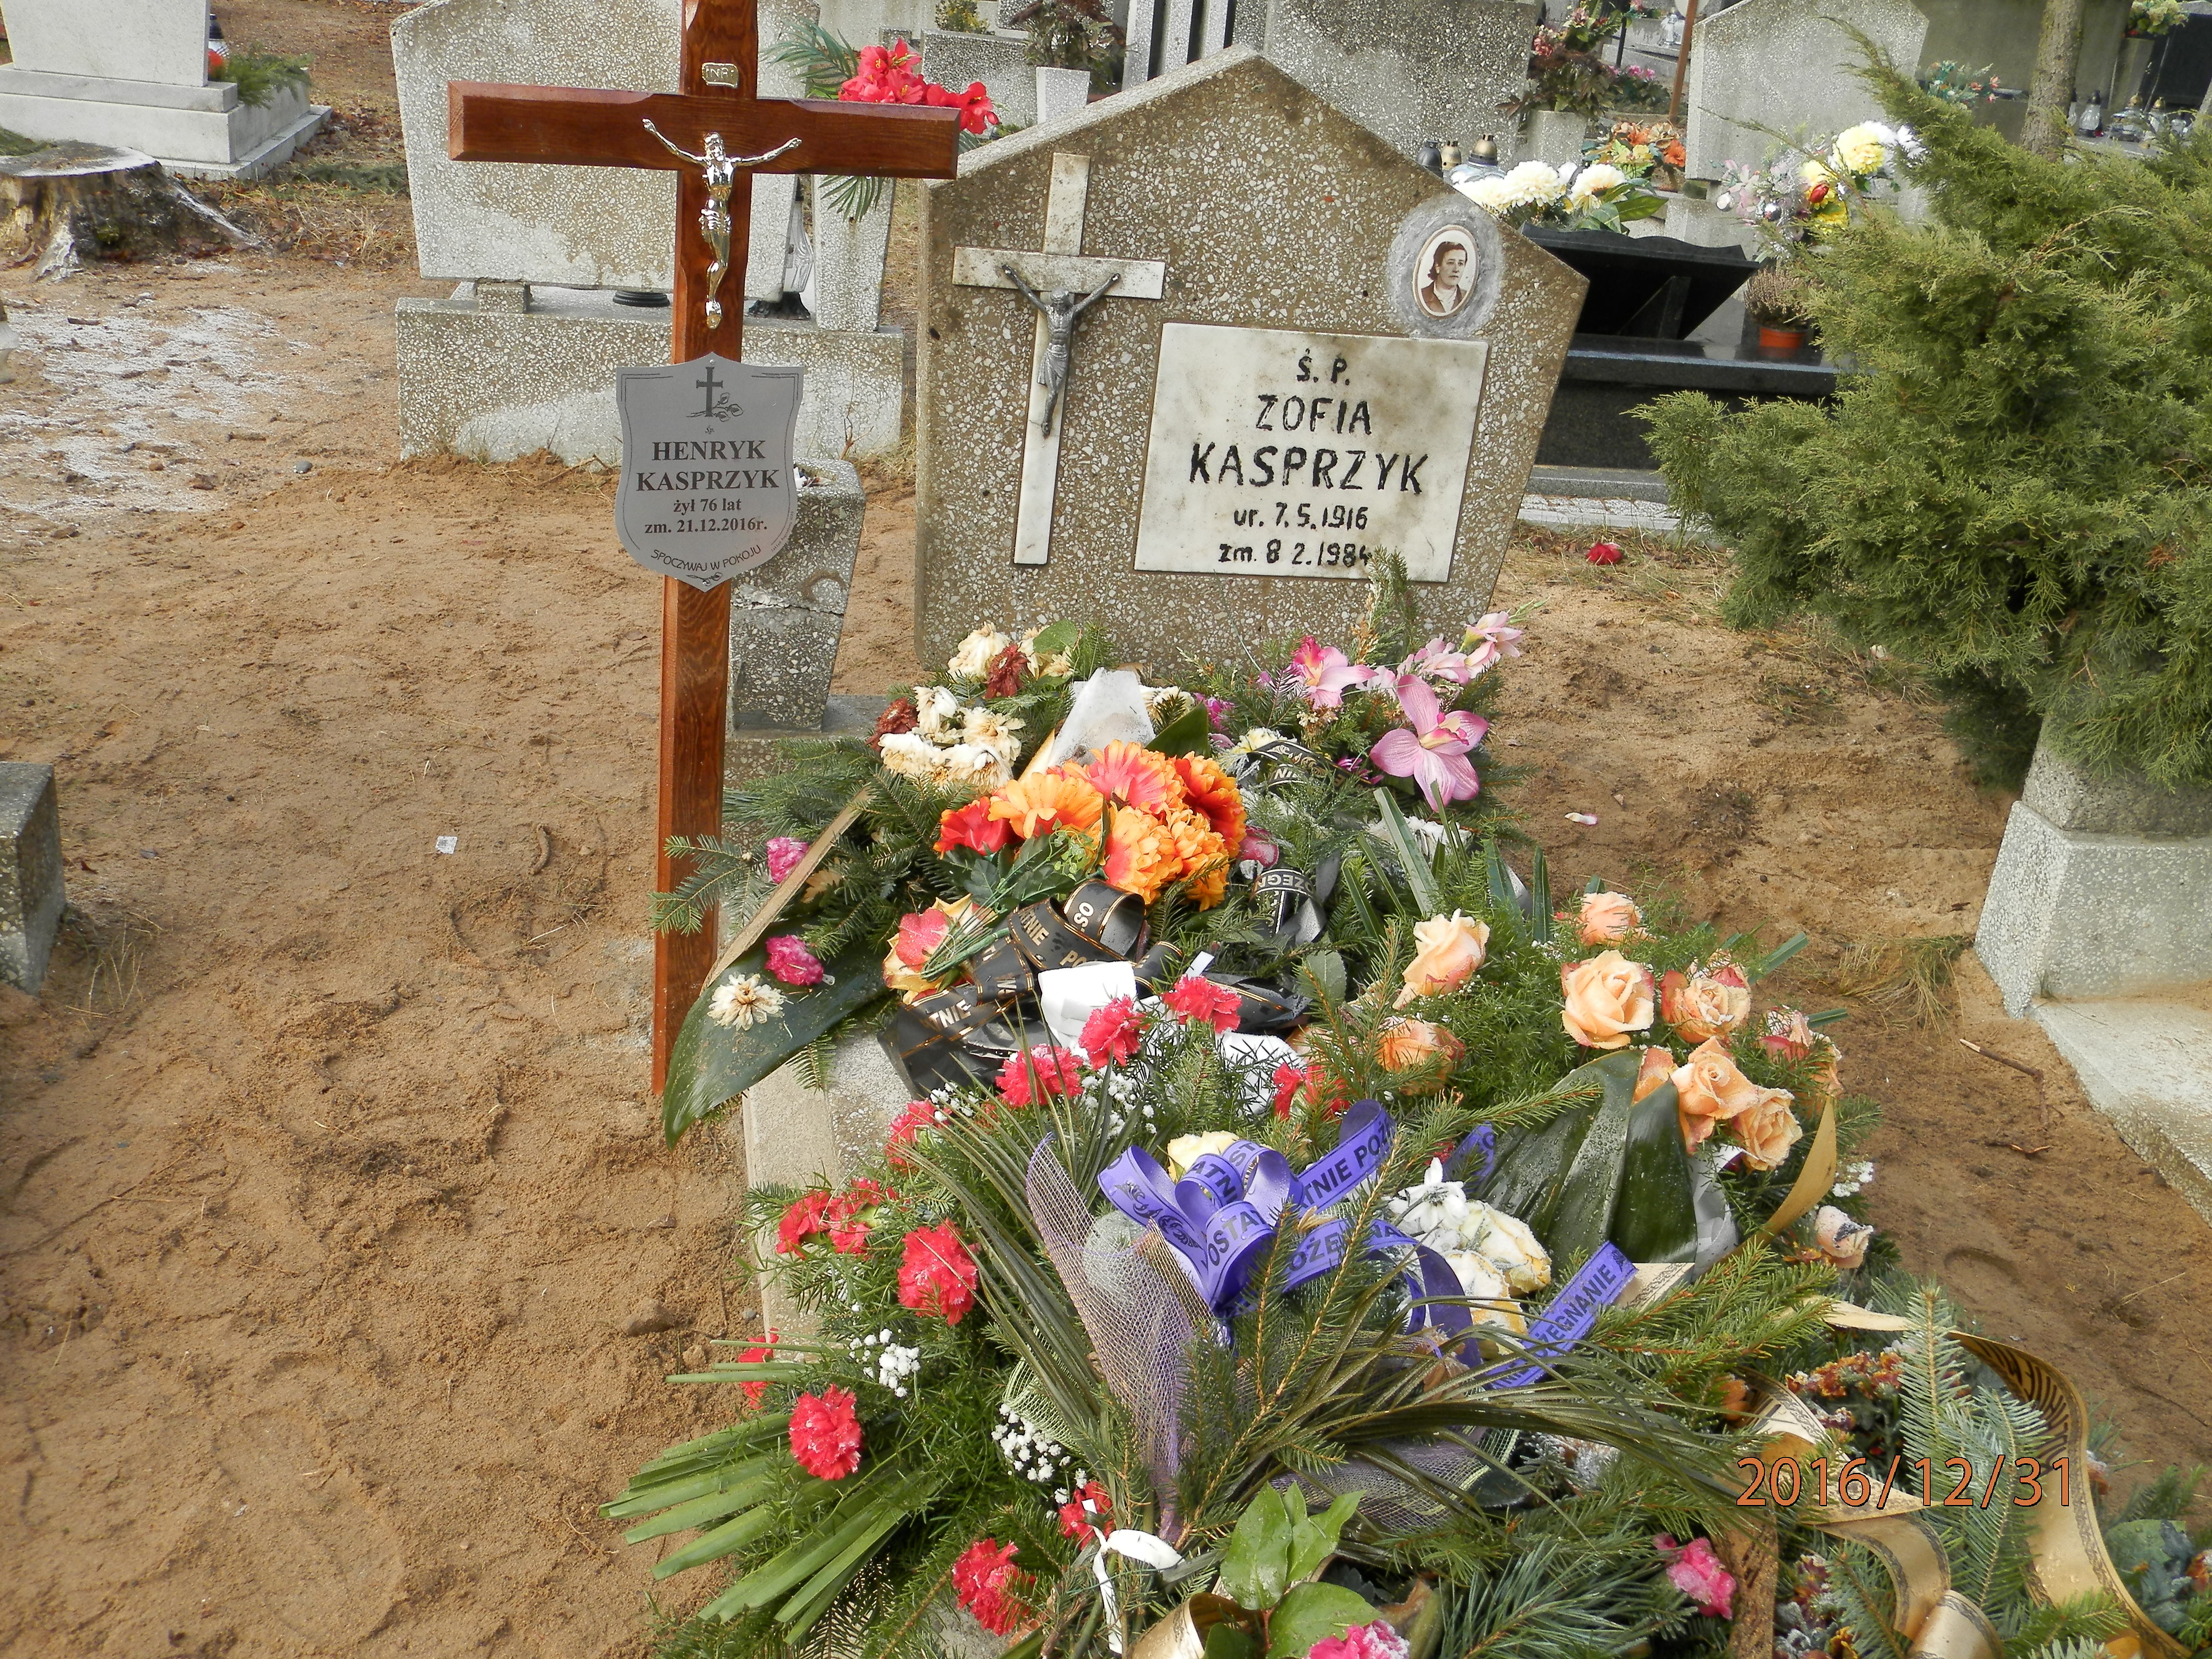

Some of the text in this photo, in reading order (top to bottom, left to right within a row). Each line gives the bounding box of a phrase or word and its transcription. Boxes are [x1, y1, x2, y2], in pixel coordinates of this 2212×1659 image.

[1330, 356, 1350, 385] P.
[1256, 394, 1372, 435] ZOFIA
[651, 440, 766, 461] HENRYK
[1189, 442, 1429, 494] KASPRZYK
[636, 469, 780, 492] KASPRZYK
[673, 498, 742, 516] żył 76 lat
[1234, 508, 1264, 527] ur.
[645, 517, 768, 534] zm. 21.12.2016r.
[651, 544, 761, 571] SPOCZYWAJ W POKOJU
[1219, 543, 1257, 563] zm.
